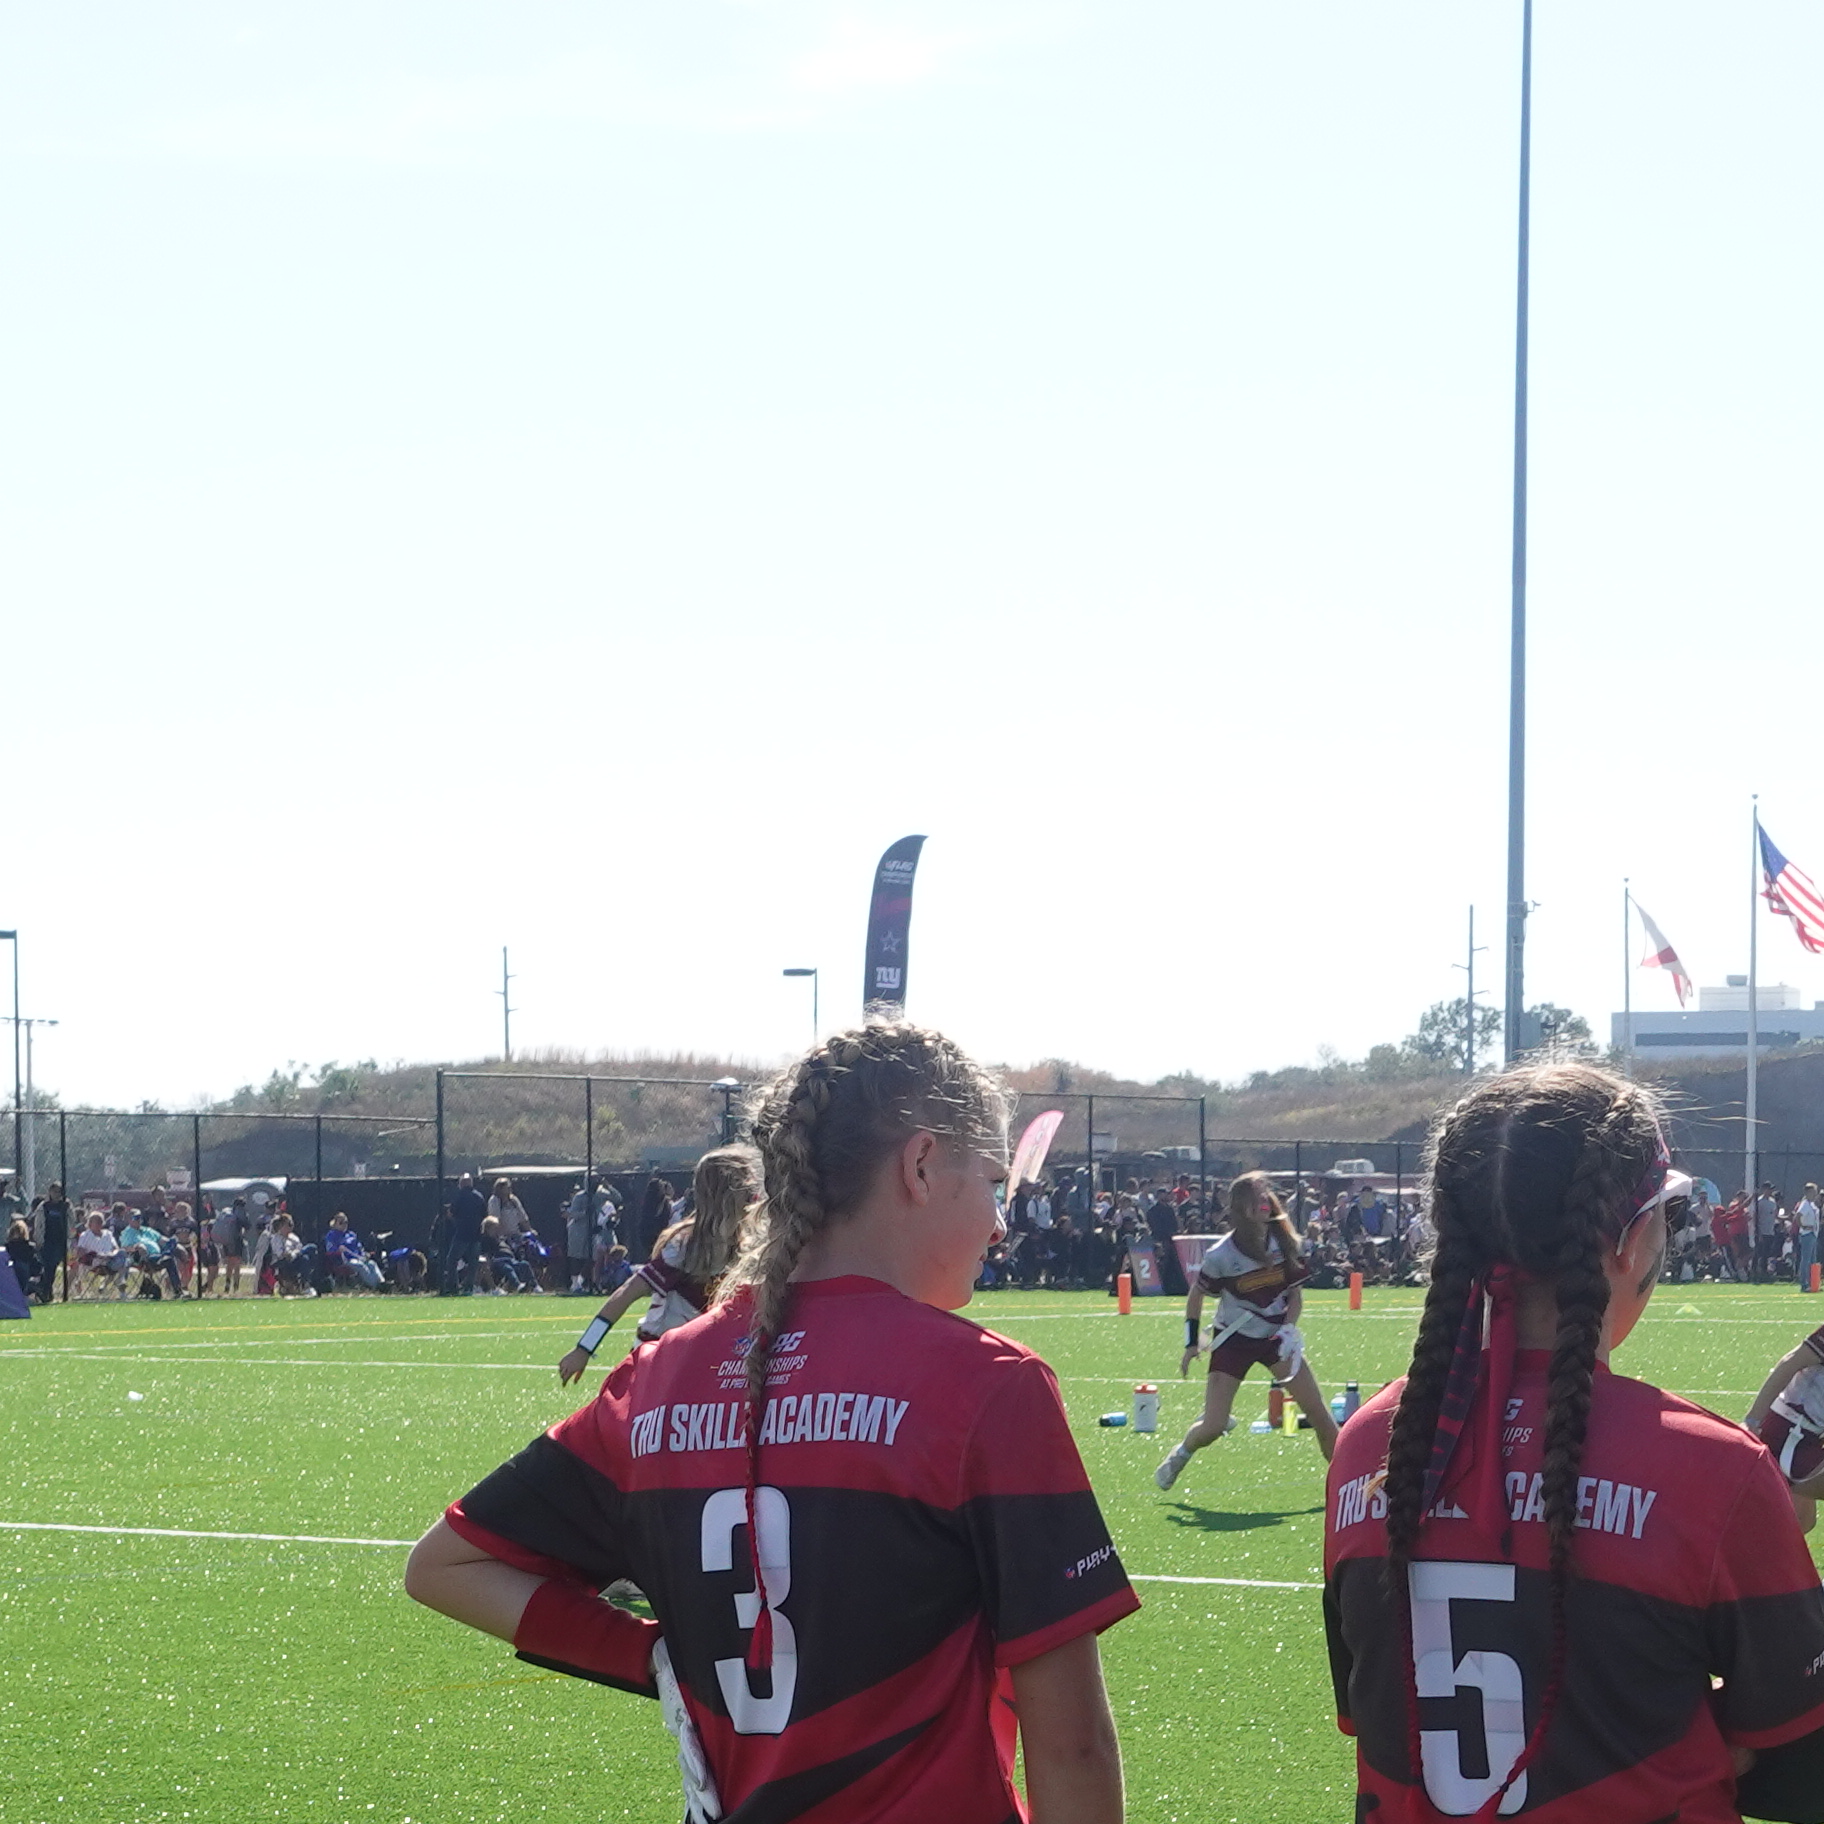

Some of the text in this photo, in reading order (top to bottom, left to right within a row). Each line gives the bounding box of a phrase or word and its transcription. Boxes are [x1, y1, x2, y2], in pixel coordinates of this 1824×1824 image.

[1139, 1259, 1151, 1279] 2
[630, 1405, 667, 1459] TRU
[758, 1393, 911, 1447] ACADEMY
[1334, 1475, 1372, 1533] TRU
[1505, 1471, 1658, 1540] CAEMY
[699, 1486, 799, 1736] 3
[1407, 1561, 1528, 1818] 5
